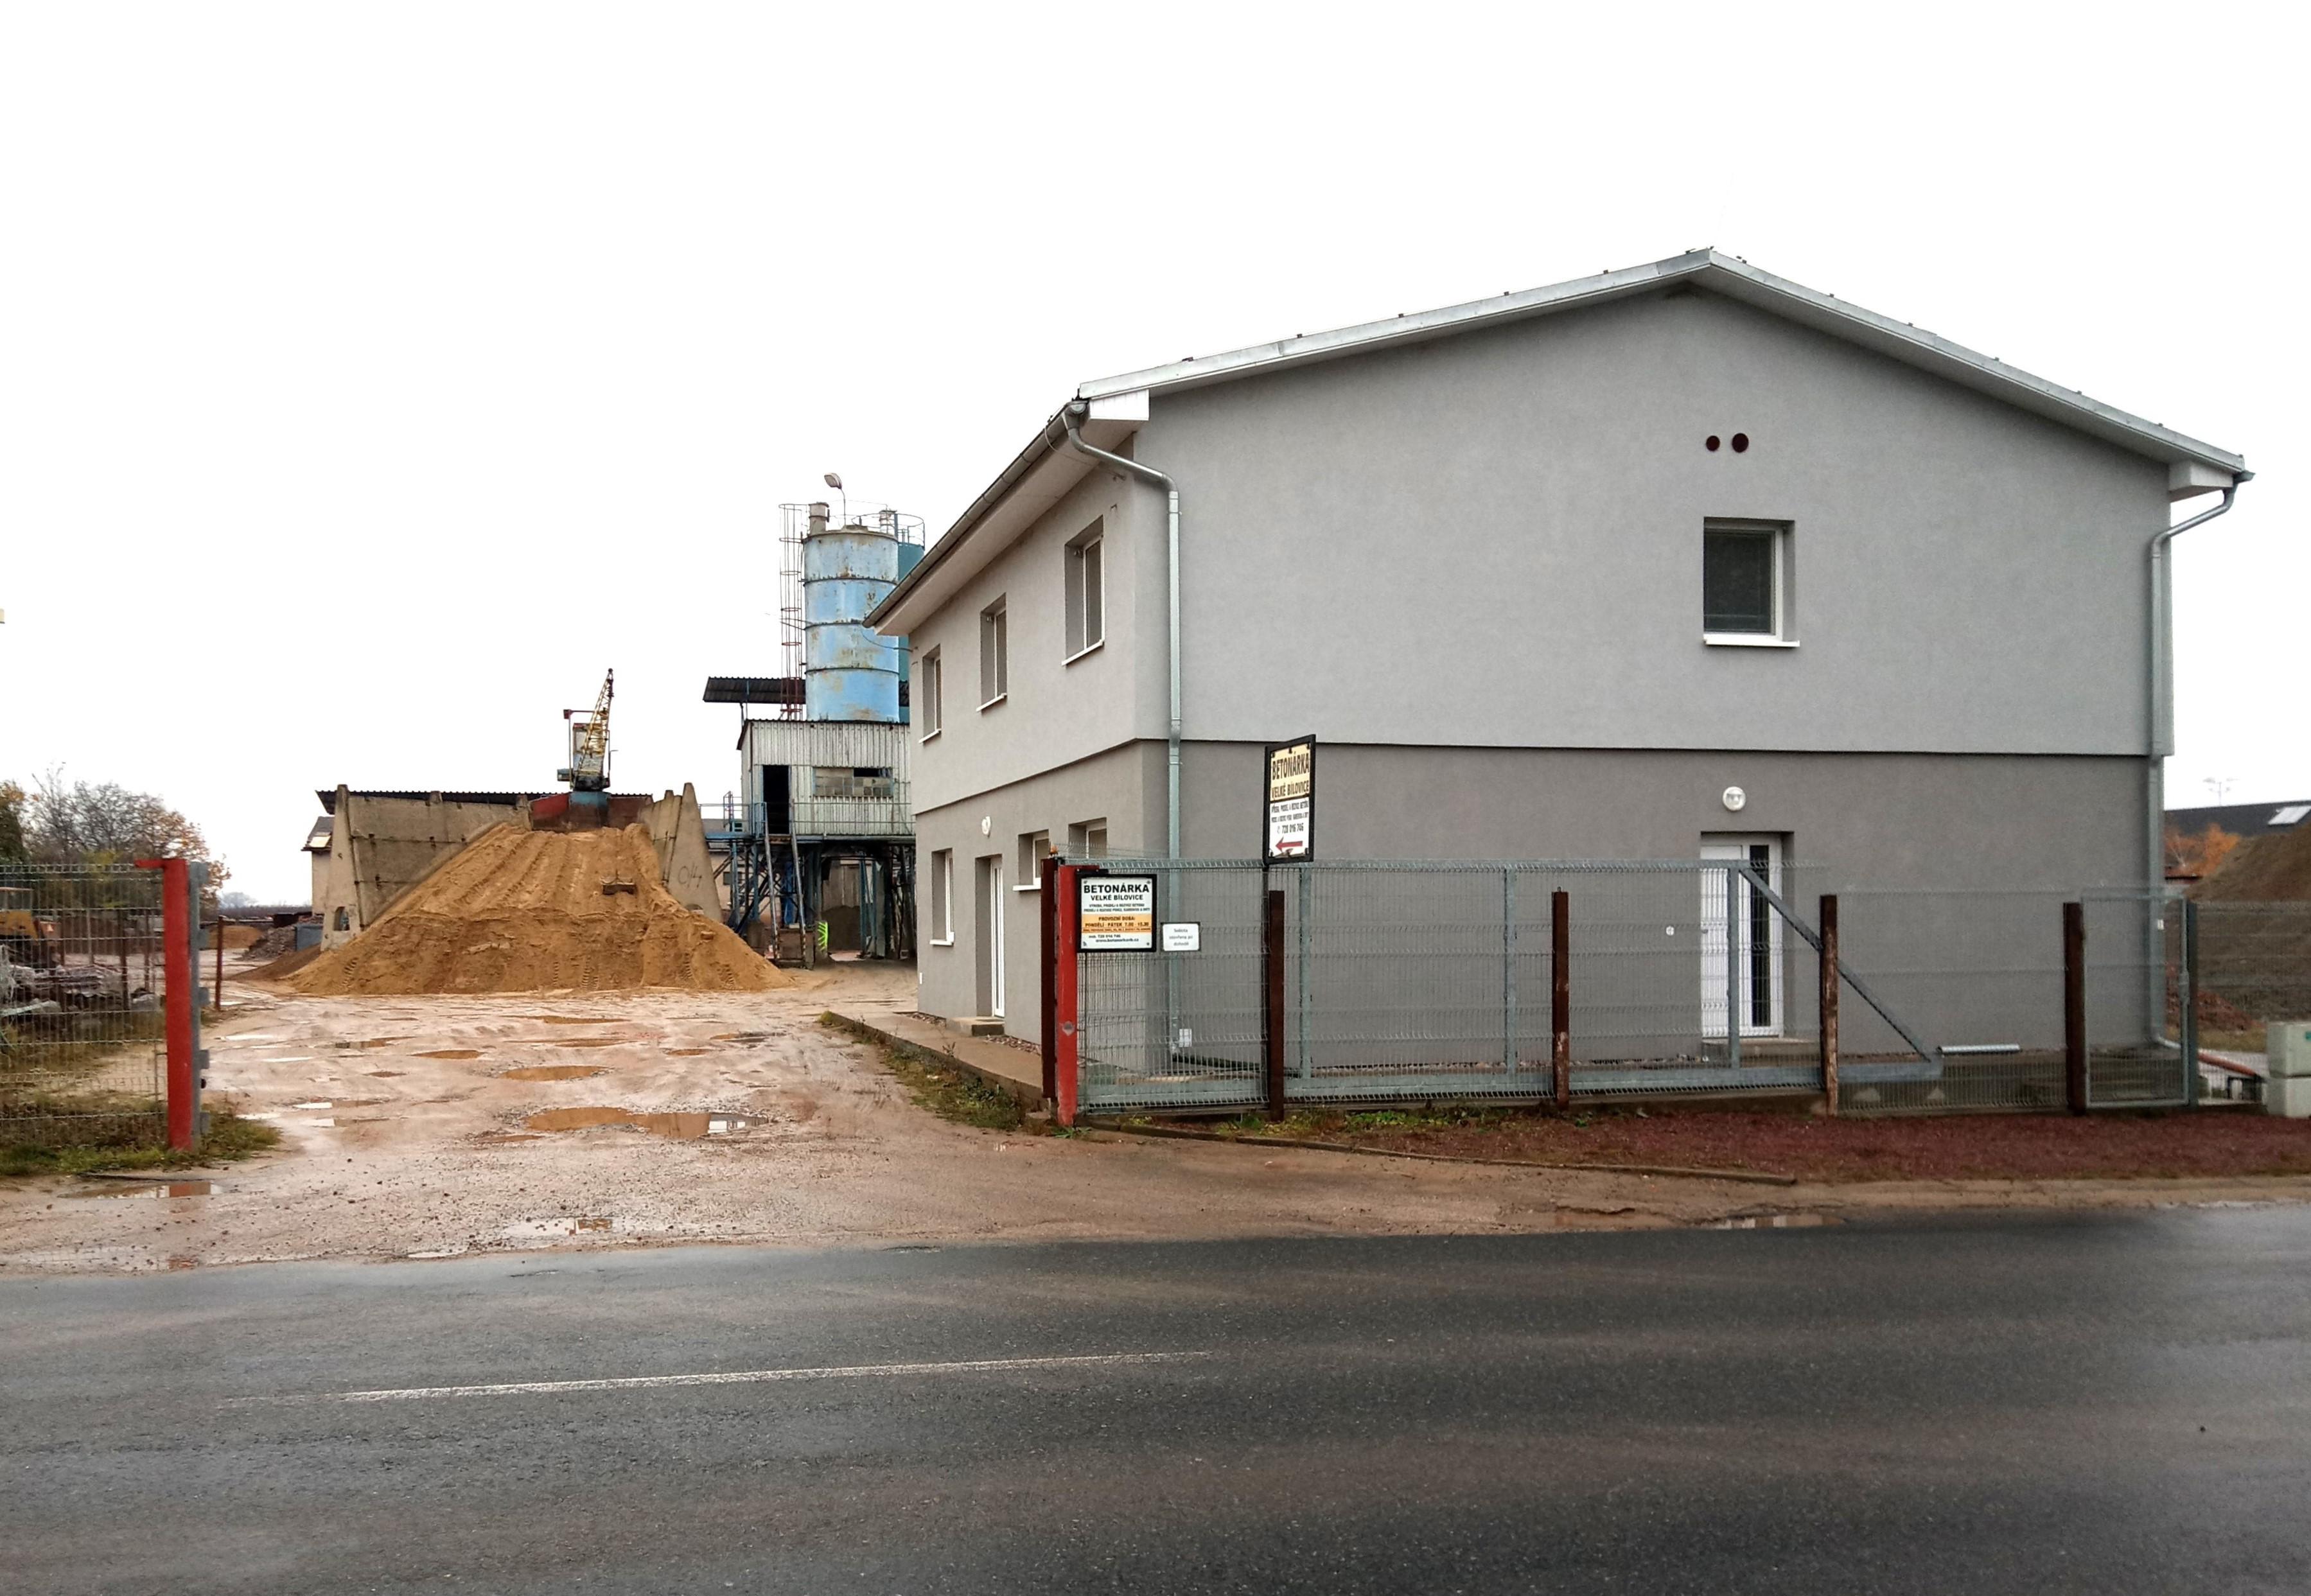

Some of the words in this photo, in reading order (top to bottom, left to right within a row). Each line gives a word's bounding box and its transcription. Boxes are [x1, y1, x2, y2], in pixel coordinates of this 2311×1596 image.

[1272, 751, 1309, 780] BETONÁRKA
[1272, 782, 1285, 798] VELKÉ
[1287, 780, 1309, 796] BÍLOVICE
[1084, 882, 1150, 893] BETONÁRKA
